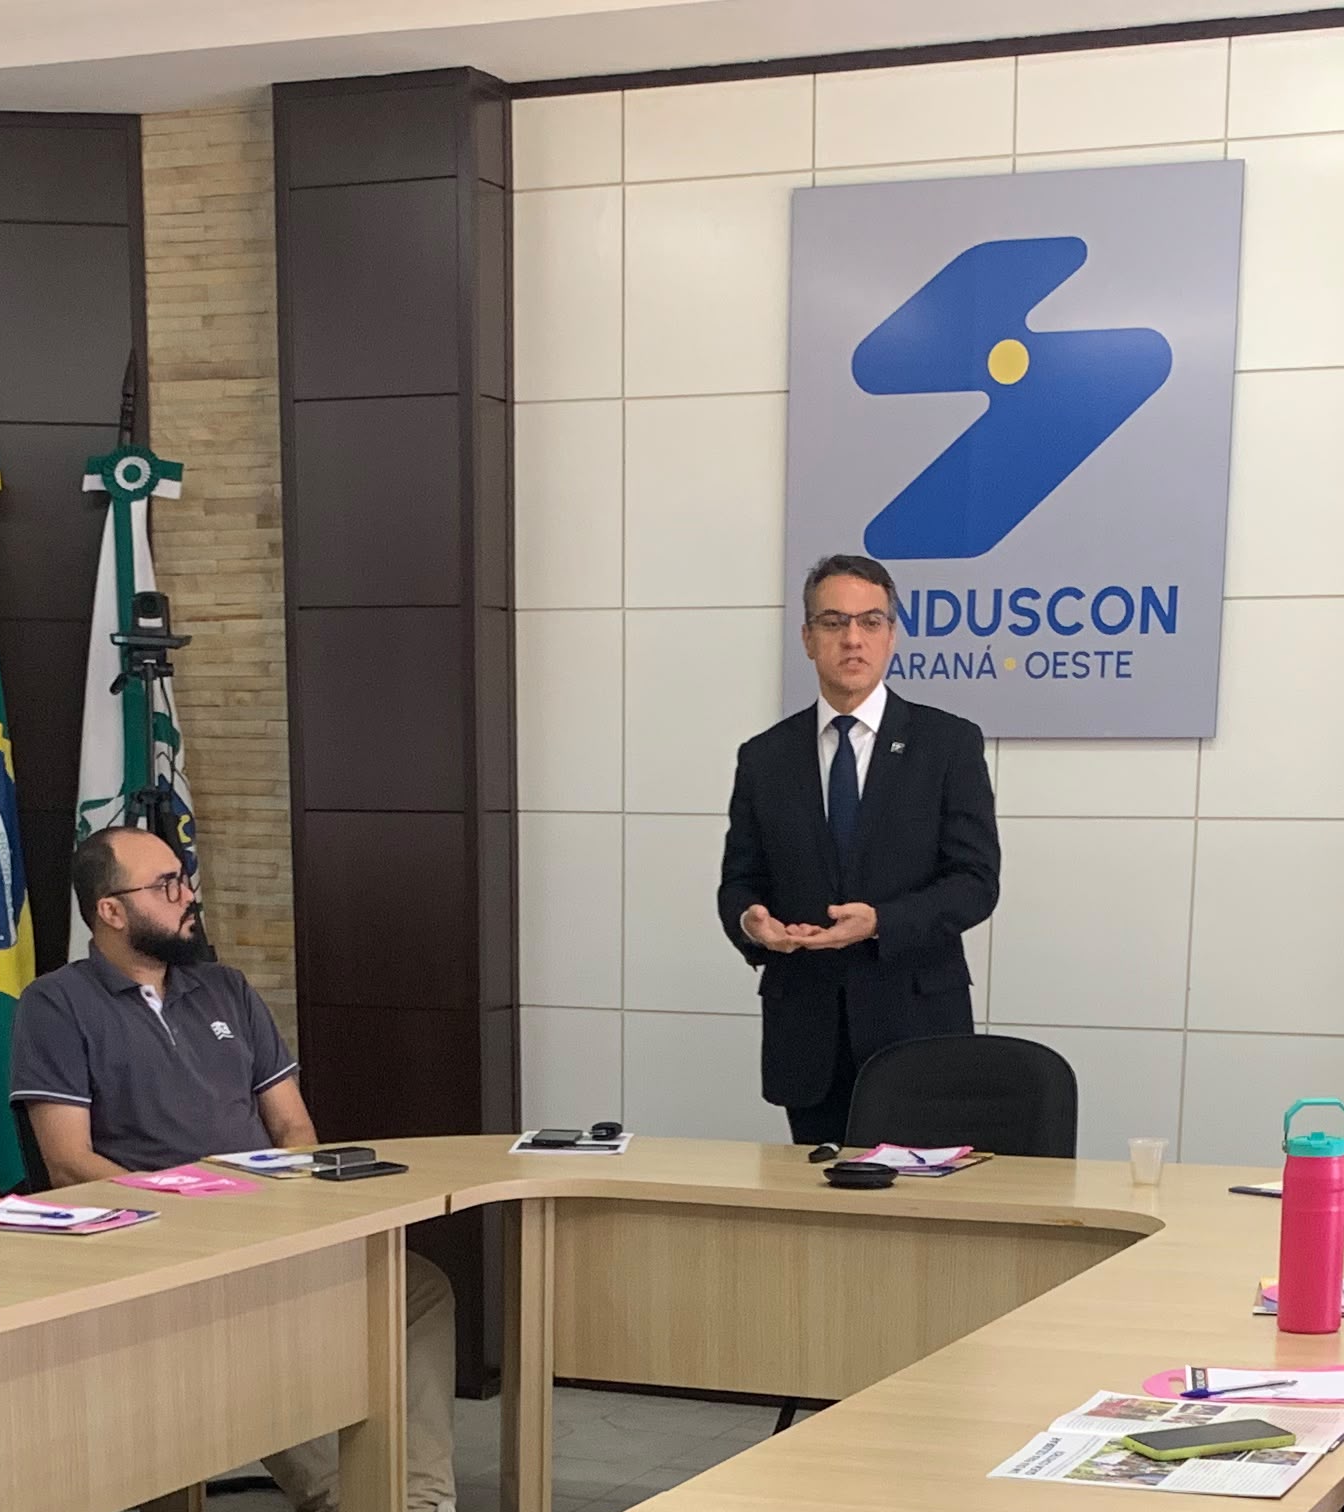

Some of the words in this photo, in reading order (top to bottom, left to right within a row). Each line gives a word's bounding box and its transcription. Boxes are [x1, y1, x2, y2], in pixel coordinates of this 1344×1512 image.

[896, 586, 1178, 637] NDUSCON
[885, 644, 997, 679] ARANÁ
[1025, 651, 1134, 679] OESTE
